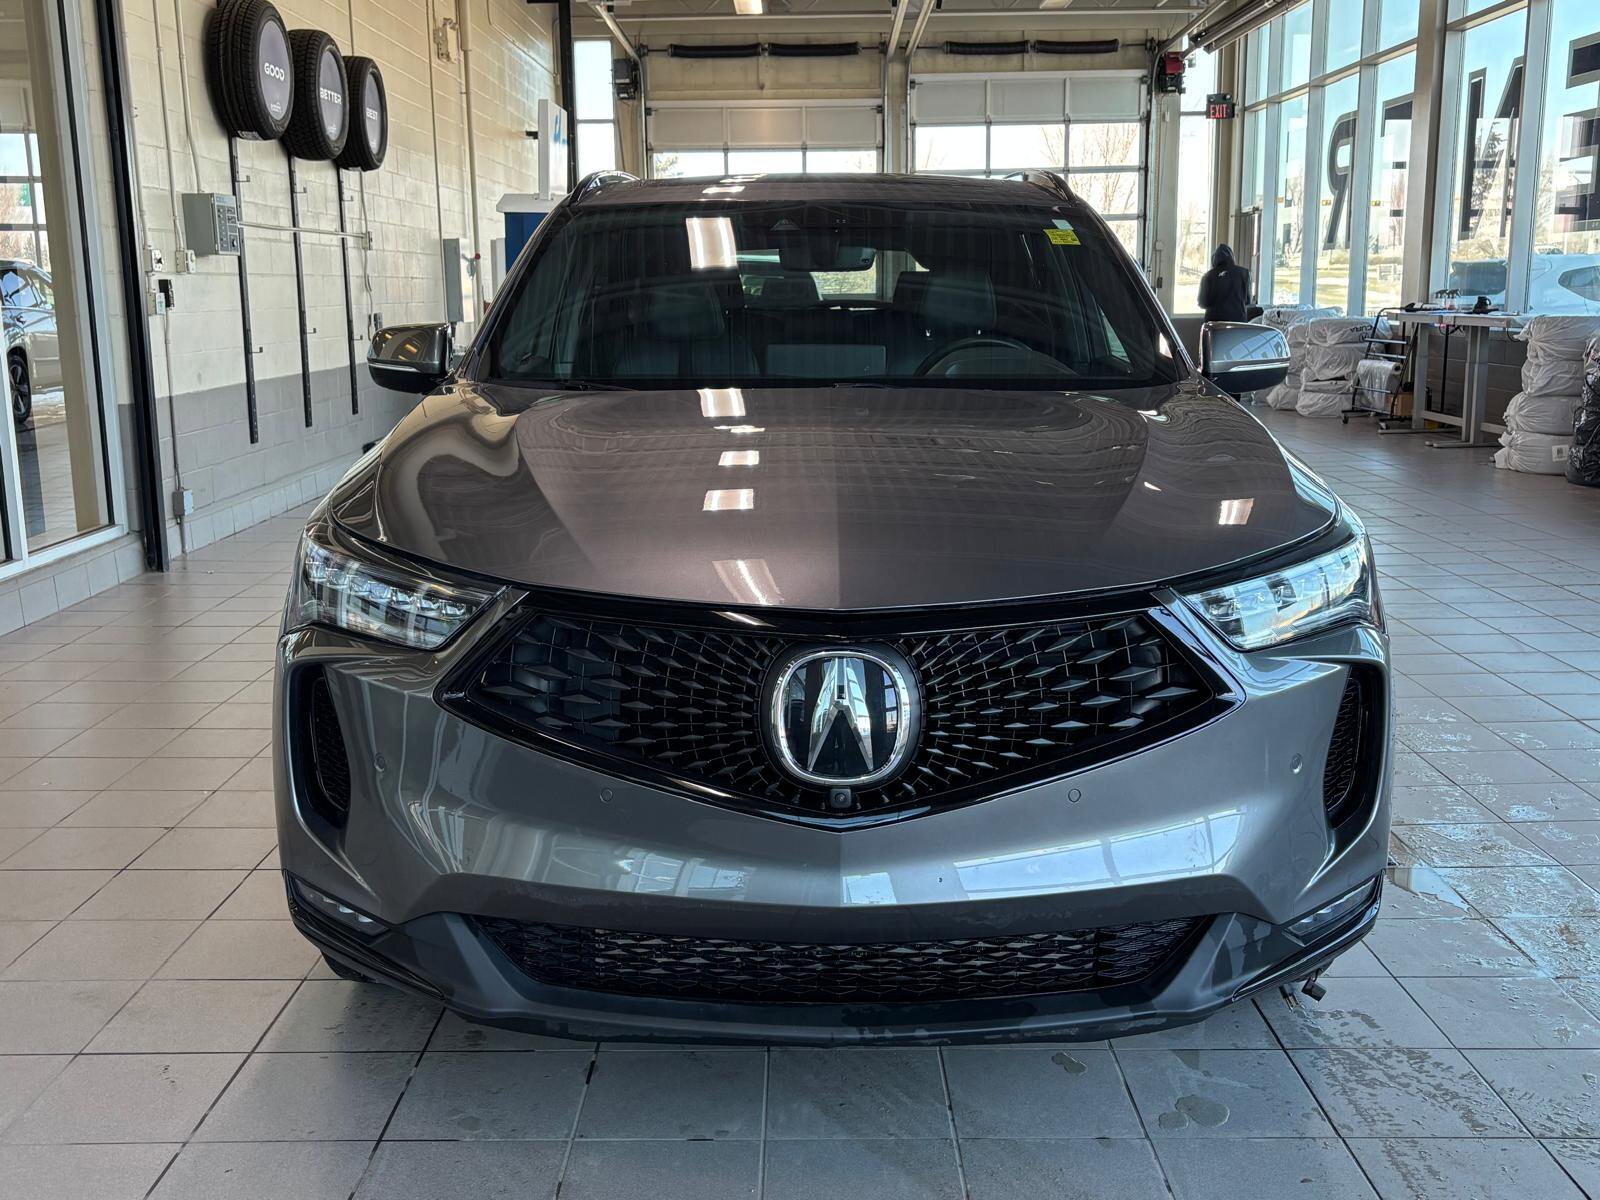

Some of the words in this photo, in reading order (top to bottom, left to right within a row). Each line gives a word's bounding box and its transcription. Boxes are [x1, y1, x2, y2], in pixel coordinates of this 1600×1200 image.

[263, 62, 285, 81] GOOD
[319, 87, 342, 105] BETTER
[365, 107, 378, 121] BEST
[1209, 104, 1227, 118] EXIT
